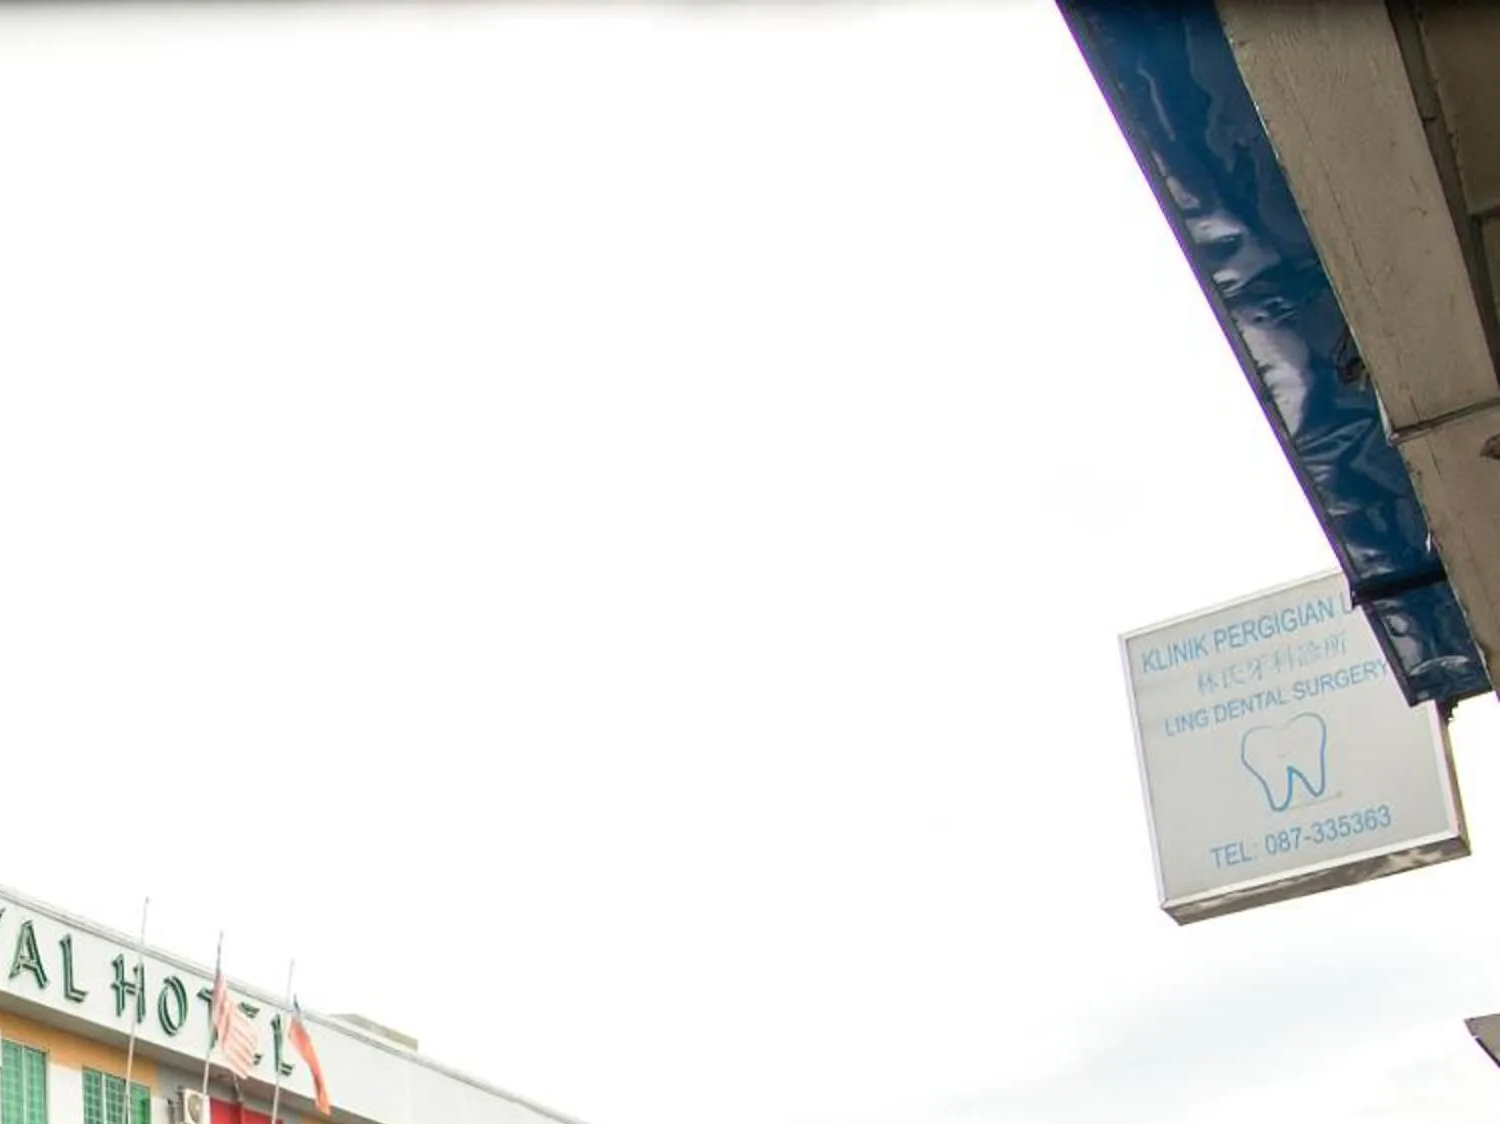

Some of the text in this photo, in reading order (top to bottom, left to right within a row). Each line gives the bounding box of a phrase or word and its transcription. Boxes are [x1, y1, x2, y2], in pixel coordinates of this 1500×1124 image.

[1142, 633, 1209, 674] KLINIK
[1213, 597, 1335, 653] PERGIGIAN
[1165, 660, 1388, 738] LING DENTAL SURGERY
[1265, 804, 1392, 856] 087-335363
